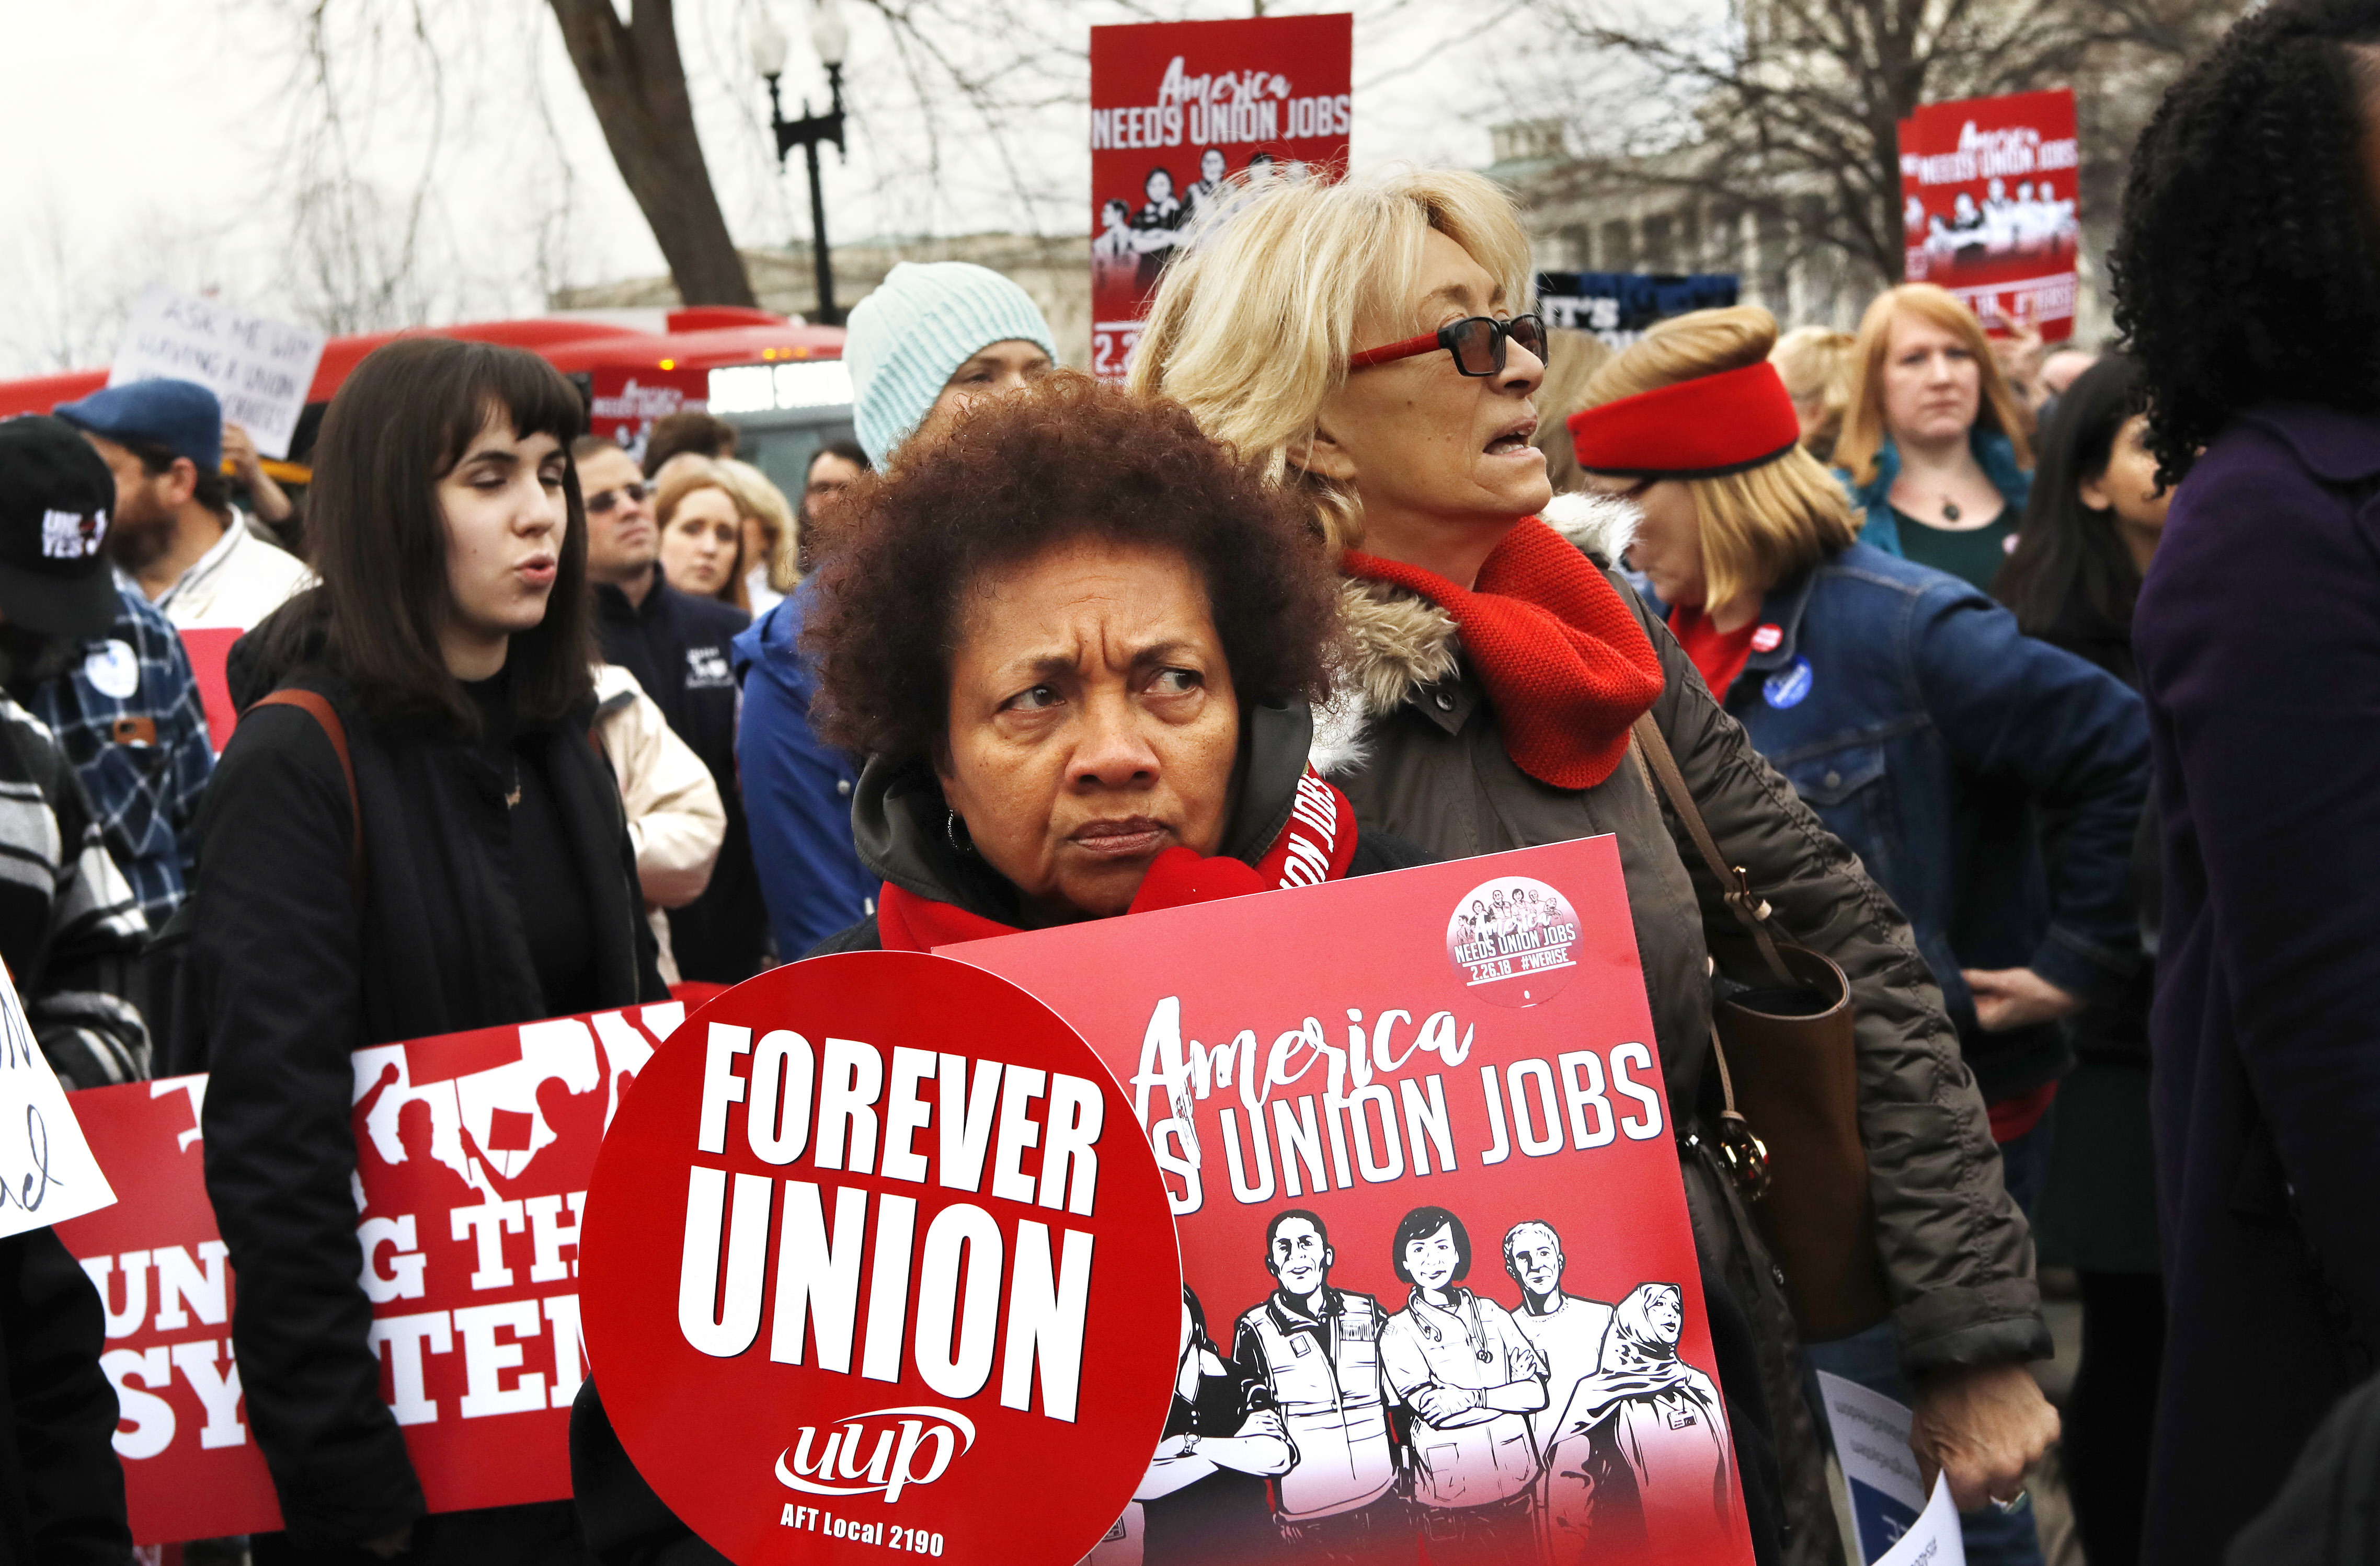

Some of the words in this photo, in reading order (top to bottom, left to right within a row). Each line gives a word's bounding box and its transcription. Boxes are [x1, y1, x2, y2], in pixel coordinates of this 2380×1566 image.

[1157, 55, 1292, 111] America
[1092, 106, 1184, 150] NEEDS
[1189, 99, 1277, 145] UNION
[1283, 94, 1351, 140] JOBS
[1454, 939, 1497, 963] NEEDS
[1497, 929, 1541, 954] UNION
[1543, 922, 1576, 946] JOBS
[1470, 959, 1512, 981] 2.26.18
[1520, 948, 1569, 970] #WERISE
[1474, 912, 1551, 946] America
[1130, 995, 1474, 1155] America
[697, 1021, 1105, 1217] FOREVER
[1218, 1073, 1459, 1205] UNION
[1479, 1041, 1665, 1166] JOBS
[450, 1190, 588, 1291] TH
[678, 1164, 1095, 1424] UNION
[791, 1414, 957, 1503] uup
[780, 1502, 820, 1532] AFT
[822, 1511, 884, 1546] Local
[888, 1525, 945, 1557] 2190
